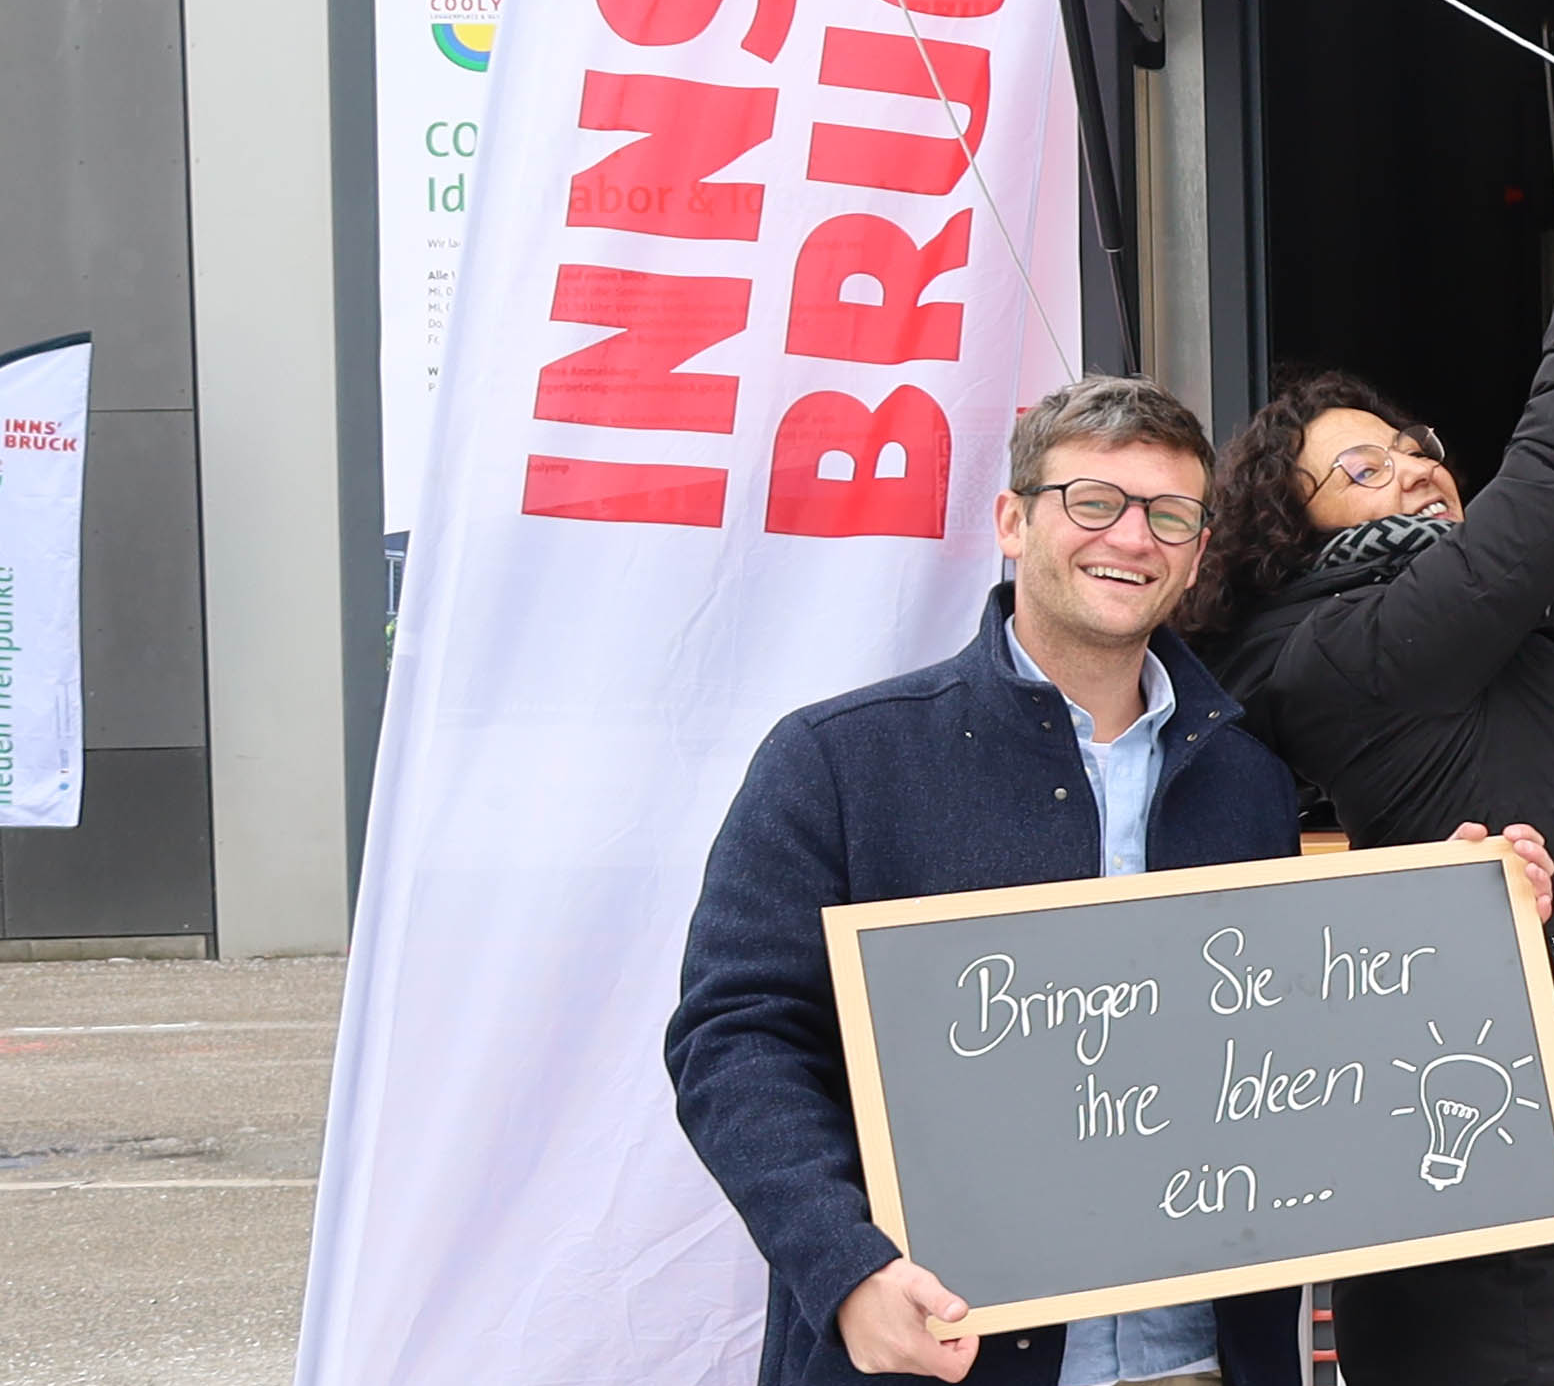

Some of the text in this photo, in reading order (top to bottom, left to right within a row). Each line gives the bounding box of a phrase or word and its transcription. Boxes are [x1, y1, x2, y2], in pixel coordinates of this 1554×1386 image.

[4, 419, 63, 436] INNS'
[4, 434, 77, 452] BRUCK
[949, 925, 1437, 1066] Bringen Sie hier
[1075, 1038, 1366, 1142] ihre Ideen
